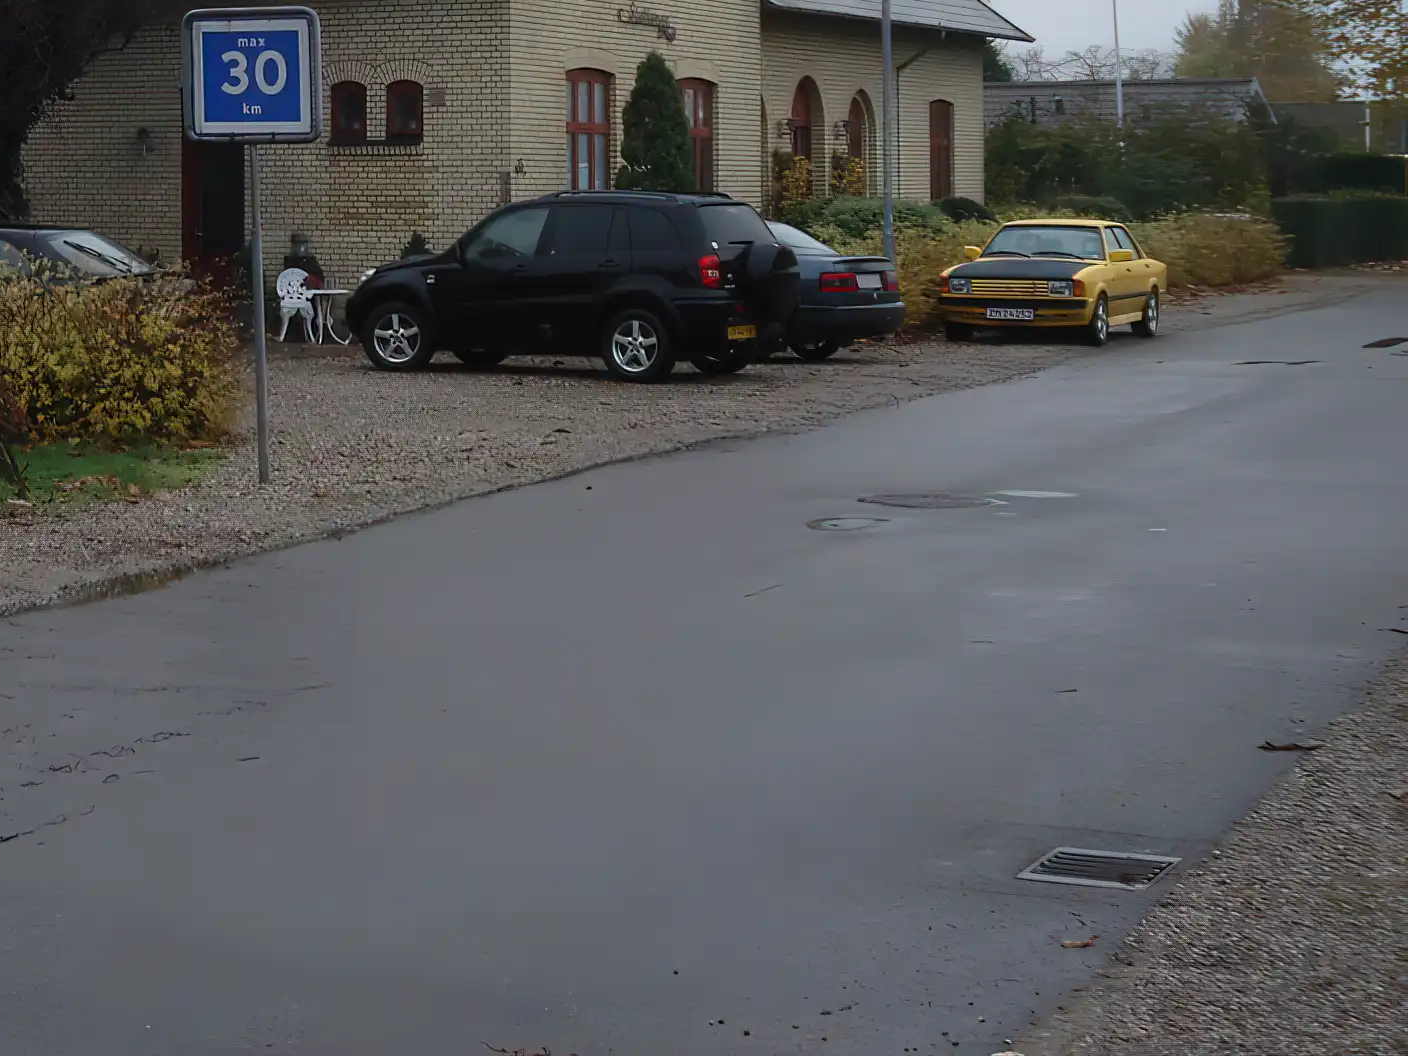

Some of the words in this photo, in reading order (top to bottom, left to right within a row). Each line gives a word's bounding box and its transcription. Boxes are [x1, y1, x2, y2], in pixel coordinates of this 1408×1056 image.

[237, 37, 266, 48] max
[220, 50, 287, 95] 30
[242, 103, 262, 115] km
